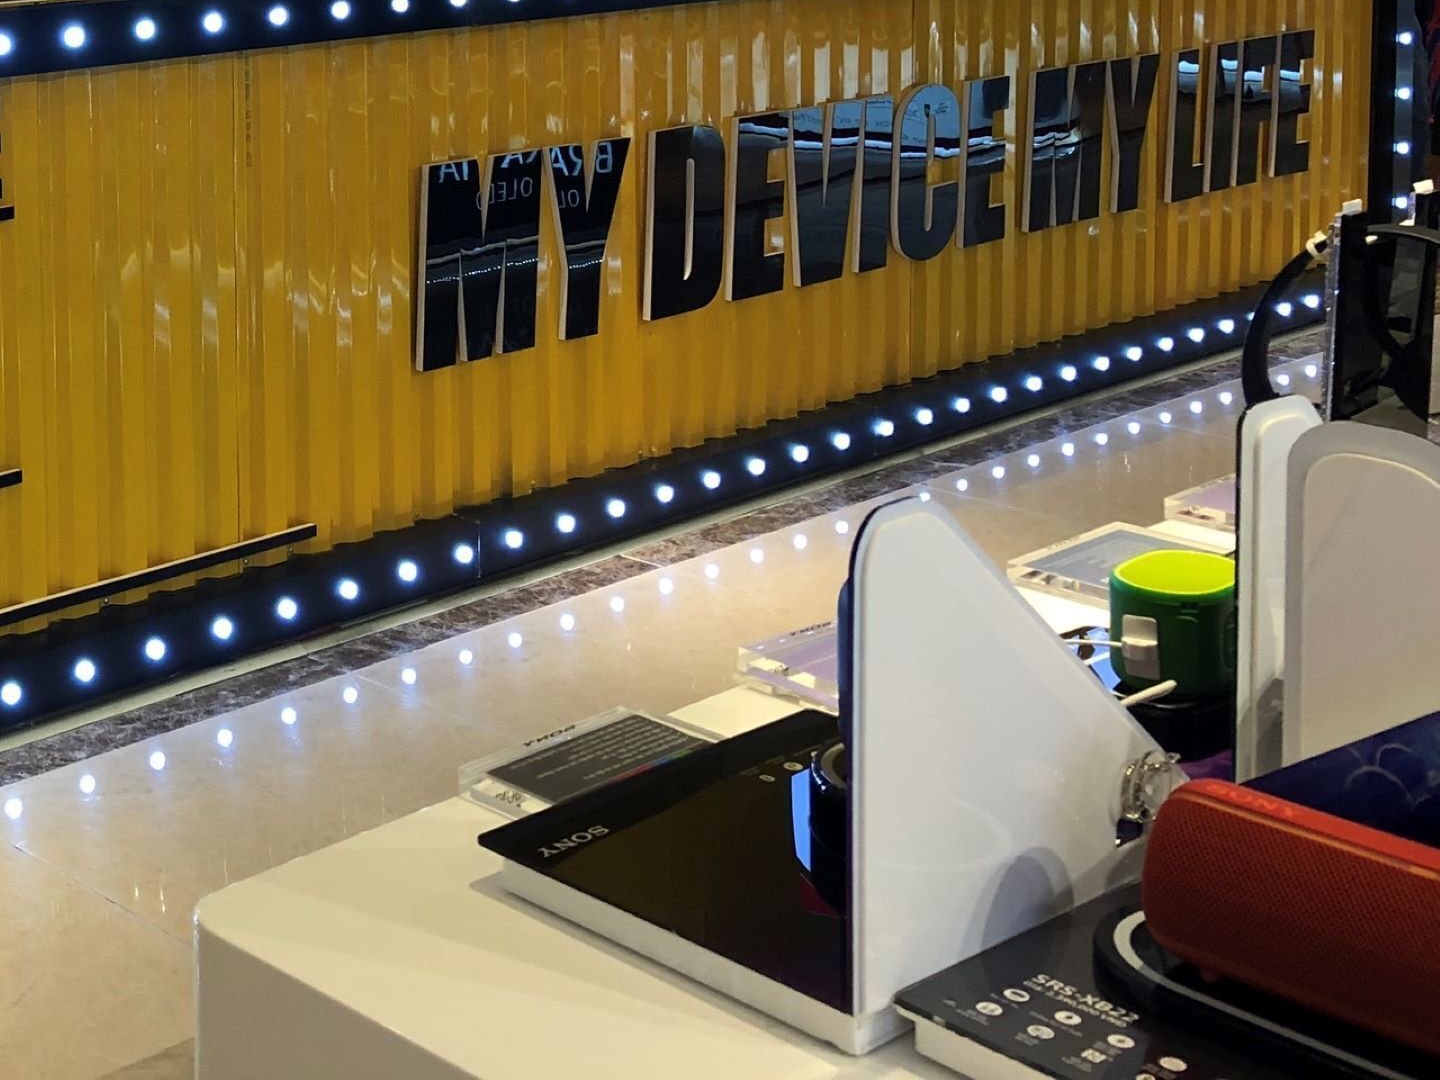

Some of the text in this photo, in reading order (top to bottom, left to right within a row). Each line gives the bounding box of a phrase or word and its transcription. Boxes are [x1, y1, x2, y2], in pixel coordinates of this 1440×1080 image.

[416, 29, 1316, 372] MY DEVICE MY LIFE
[537, 824, 610, 858] SONY
